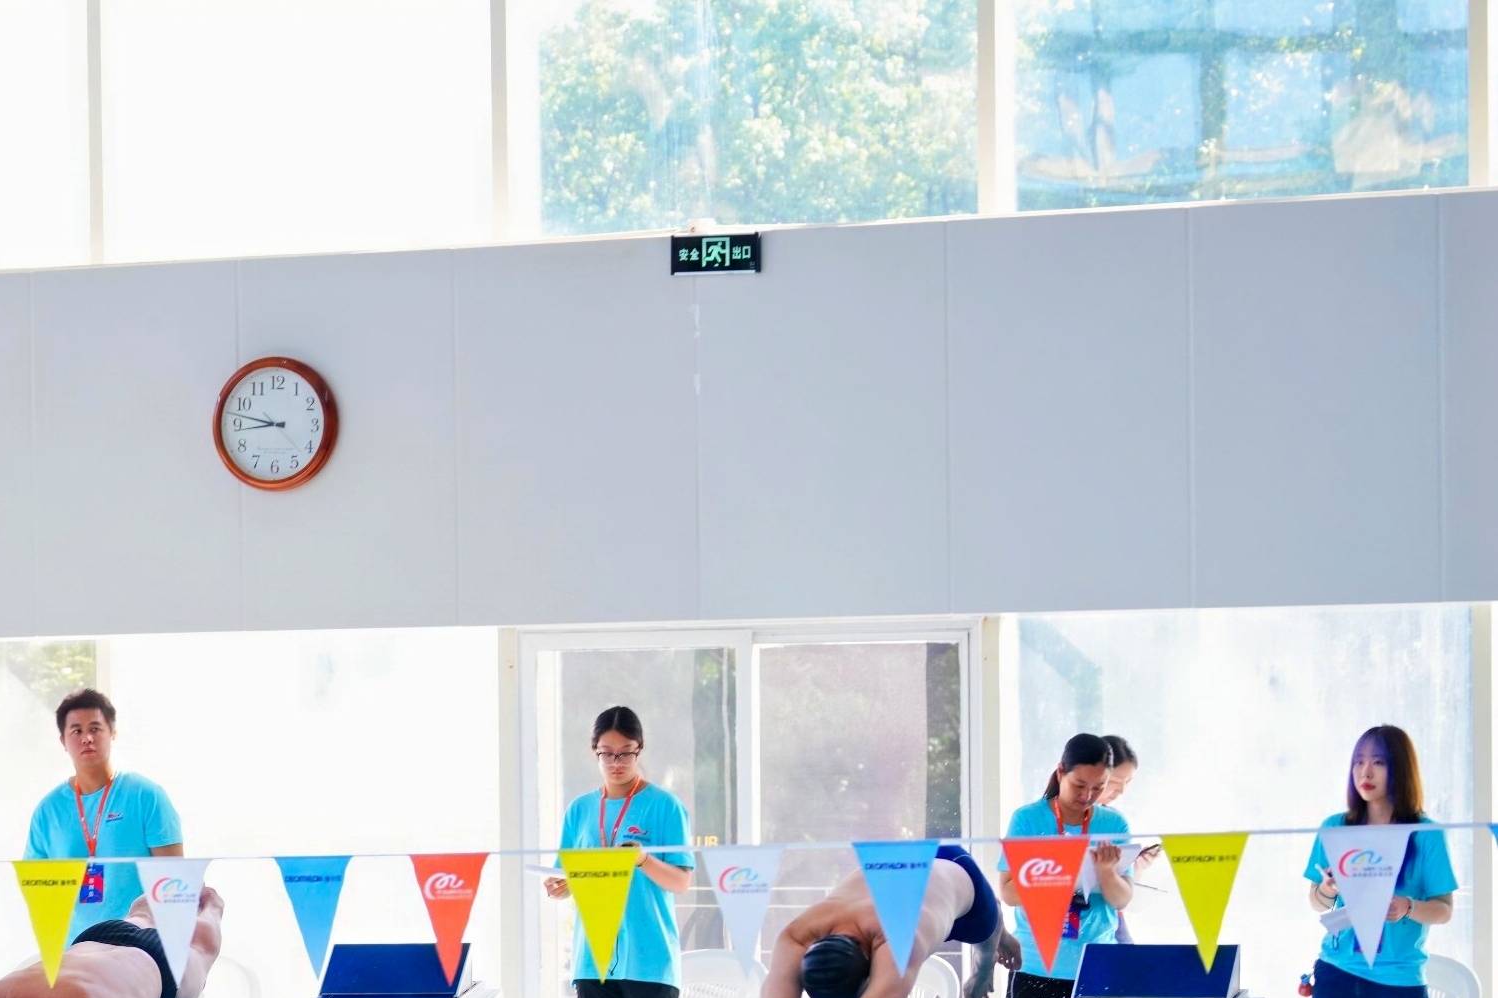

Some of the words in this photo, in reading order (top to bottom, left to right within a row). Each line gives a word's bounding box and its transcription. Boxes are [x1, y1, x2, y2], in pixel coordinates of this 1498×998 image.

[678, 247, 700, 261] 安全
[731, 245, 751, 260] 出口
[252, 381, 265, 396] 11
[270, 375, 285, 390] 12
[293, 381, 300, 396] 1
[237, 397, 252, 411] 10
[305, 397, 315, 411] 2
[233, 418, 243, 432] 9
[310, 418, 320, 432] 3
[237, 438, 247, 452] 8
[304, 440, 314, 454] 4
[251, 455, 261, 469] 7
[270, 459, 280, 474] 6
[289, 455, 299, 469] 5
